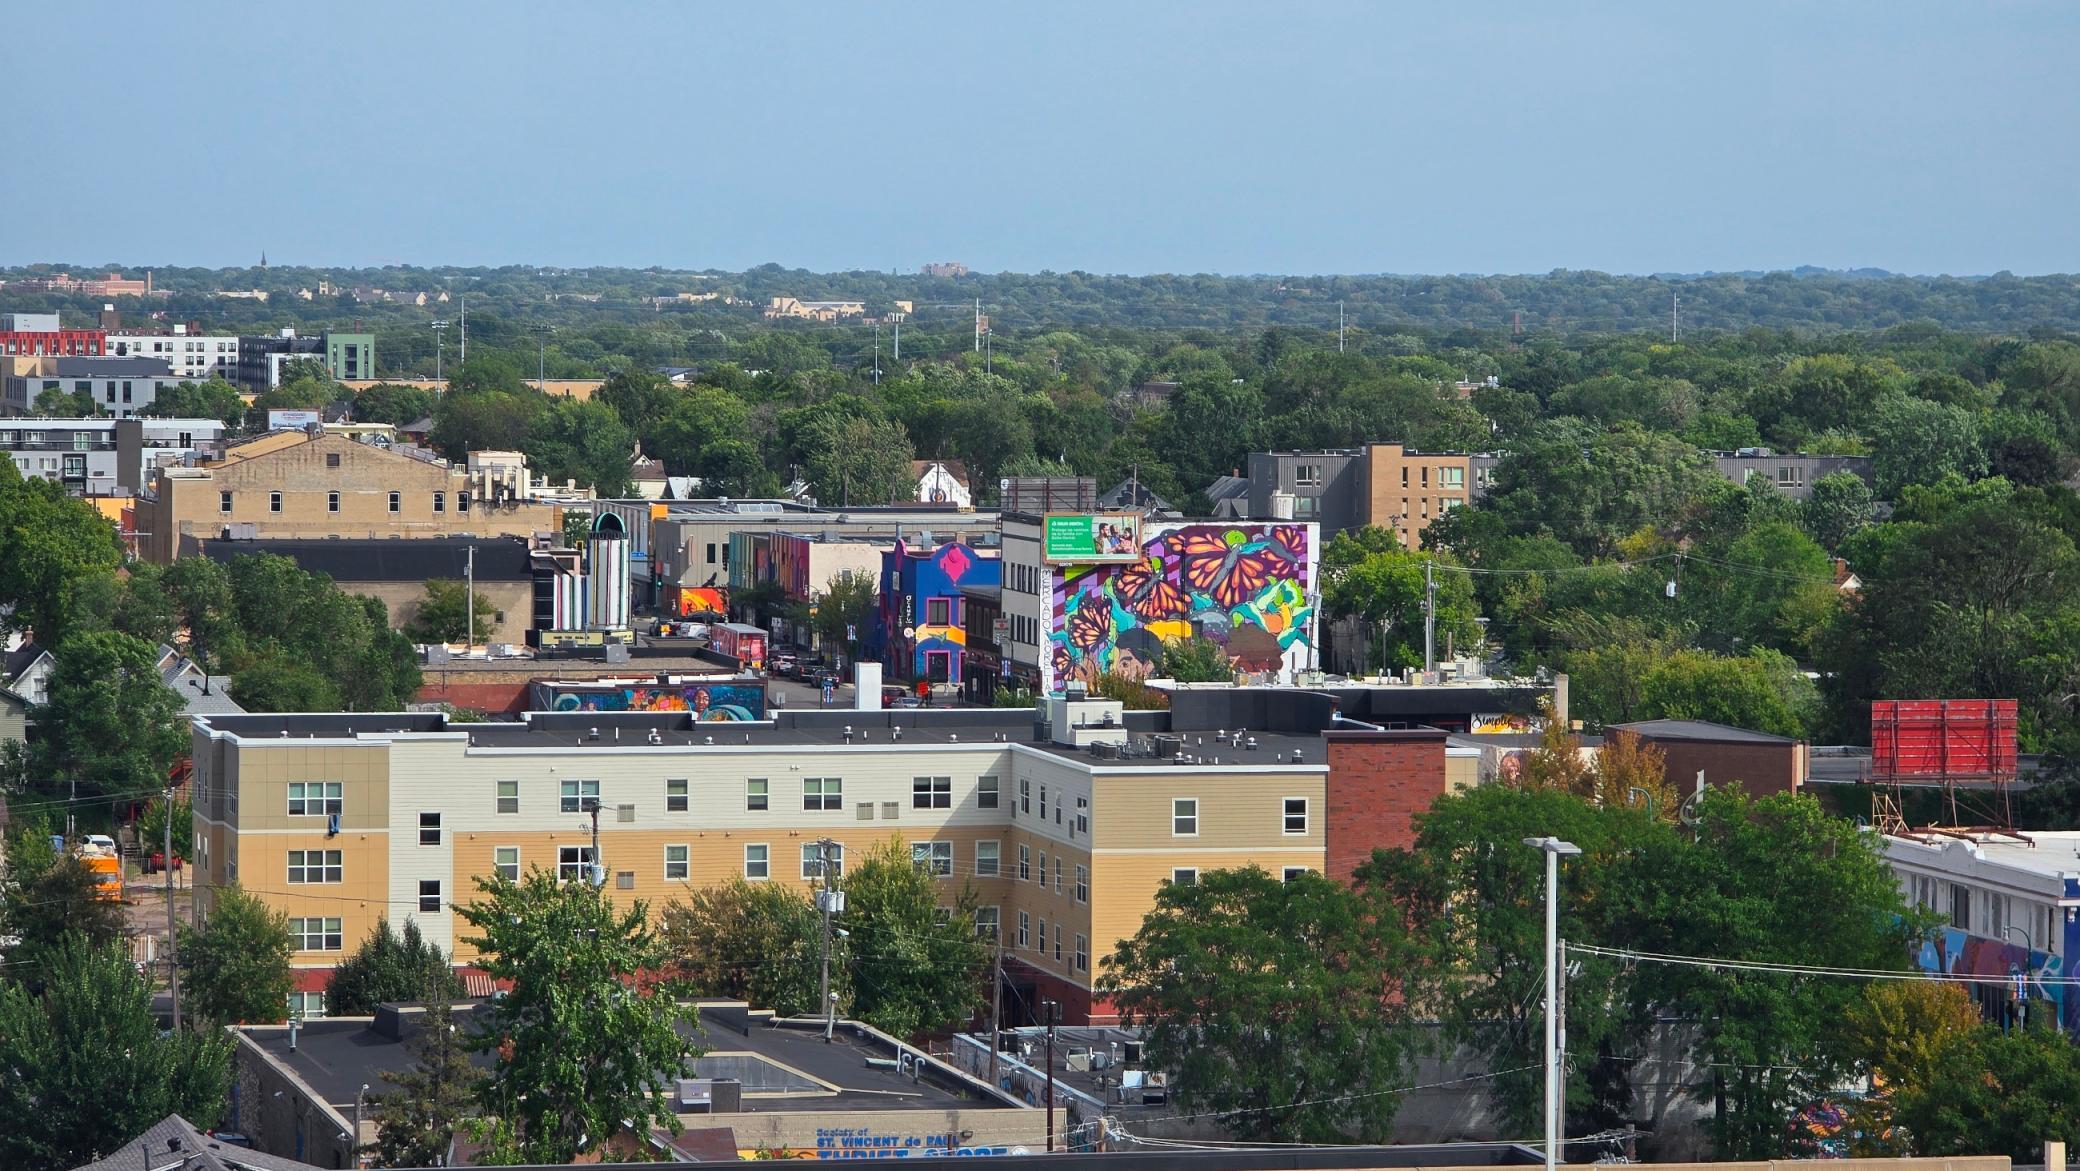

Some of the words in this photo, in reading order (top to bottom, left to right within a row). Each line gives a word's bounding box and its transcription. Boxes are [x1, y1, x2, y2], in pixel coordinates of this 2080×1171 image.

[1042, 569, 1051, 629] MERCADO
[816, 1137, 836, 1148] ST.
[841, 1136, 899, 1147] VINCENT
[904, 1136, 921, 1147] de
